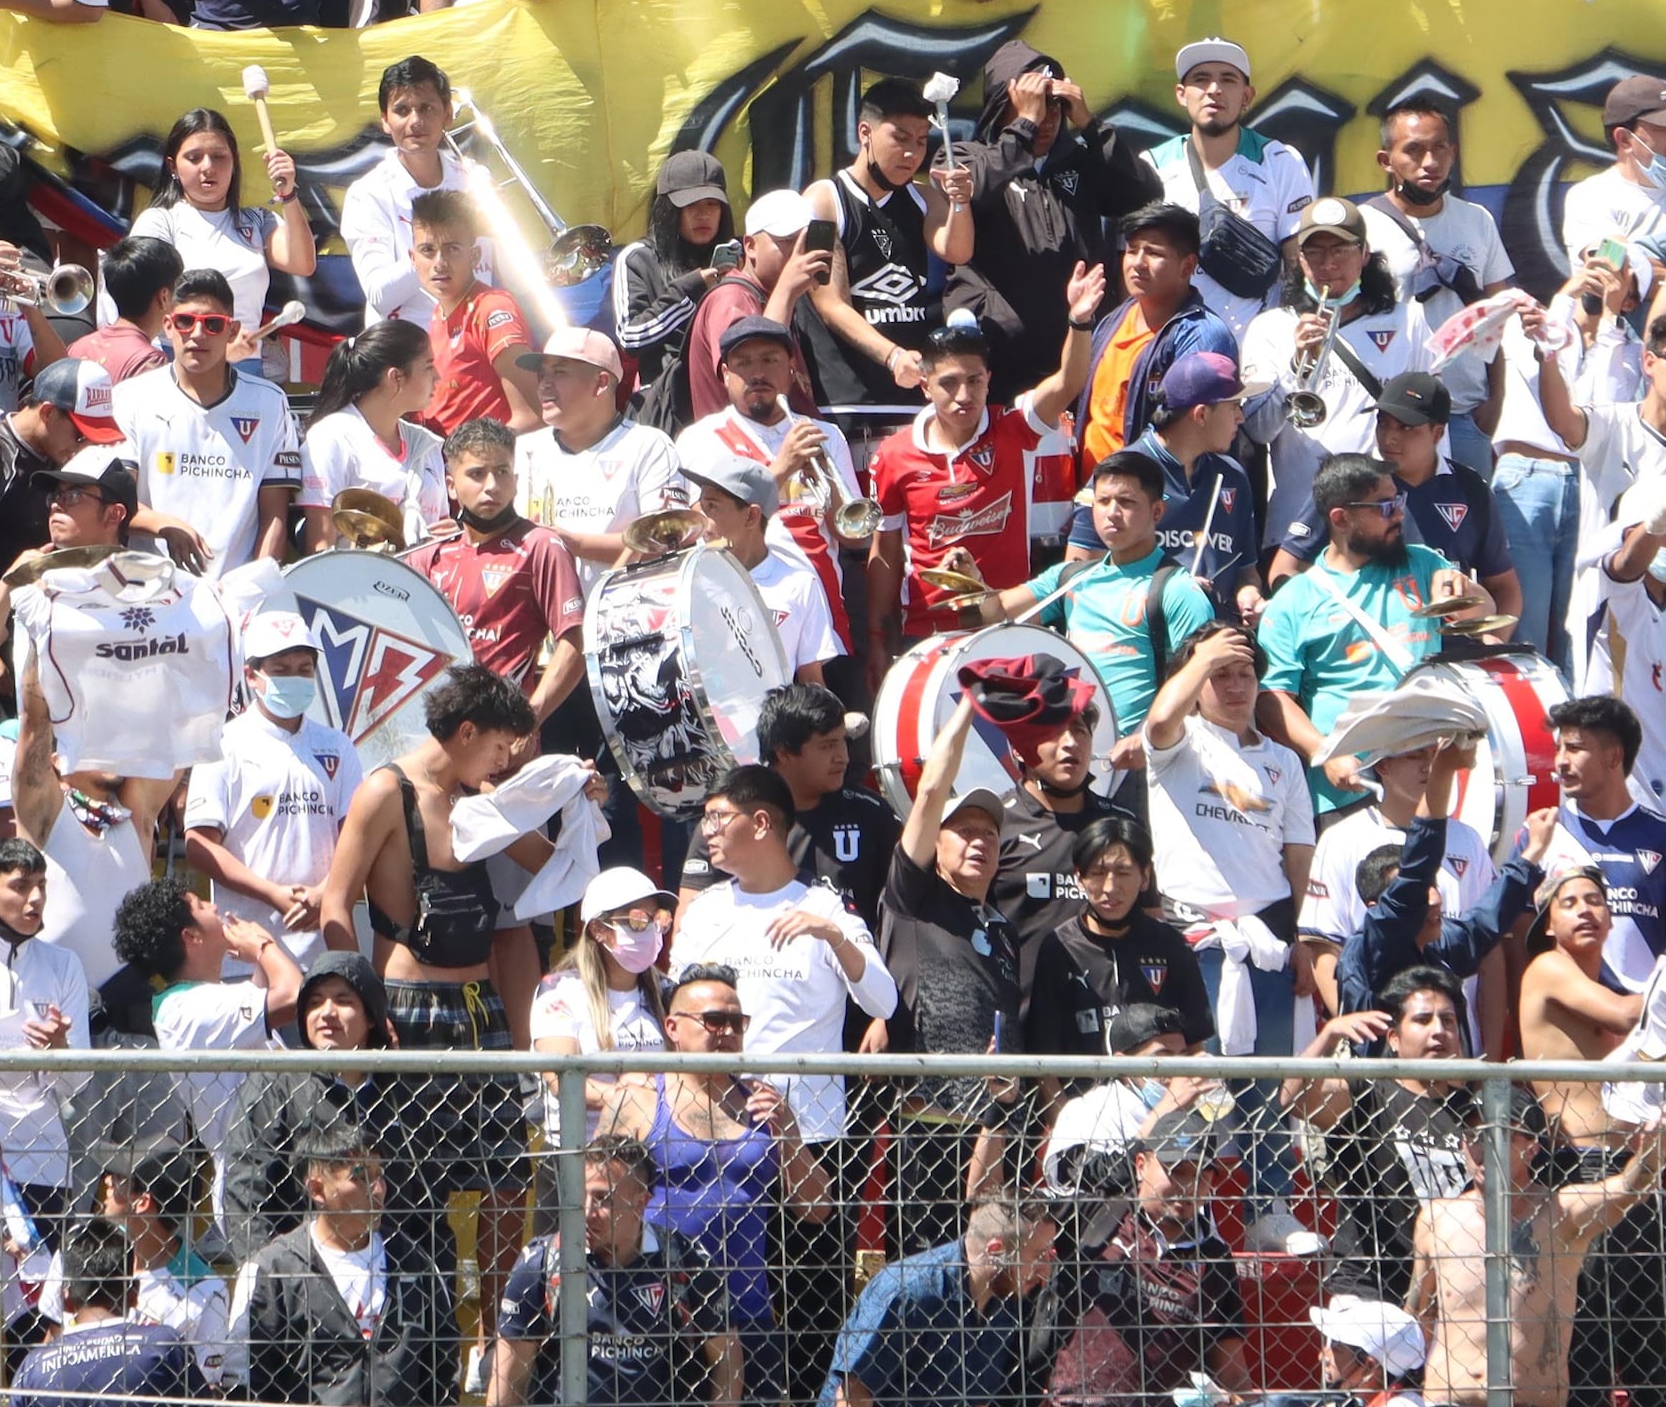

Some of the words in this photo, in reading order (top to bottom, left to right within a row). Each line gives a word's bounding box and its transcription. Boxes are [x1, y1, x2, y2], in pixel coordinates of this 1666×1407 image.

[181, 453, 226, 466] BANCO
[180, 467, 251, 480] PICHINCHA
[279, 793, 318, 803] BANCO
